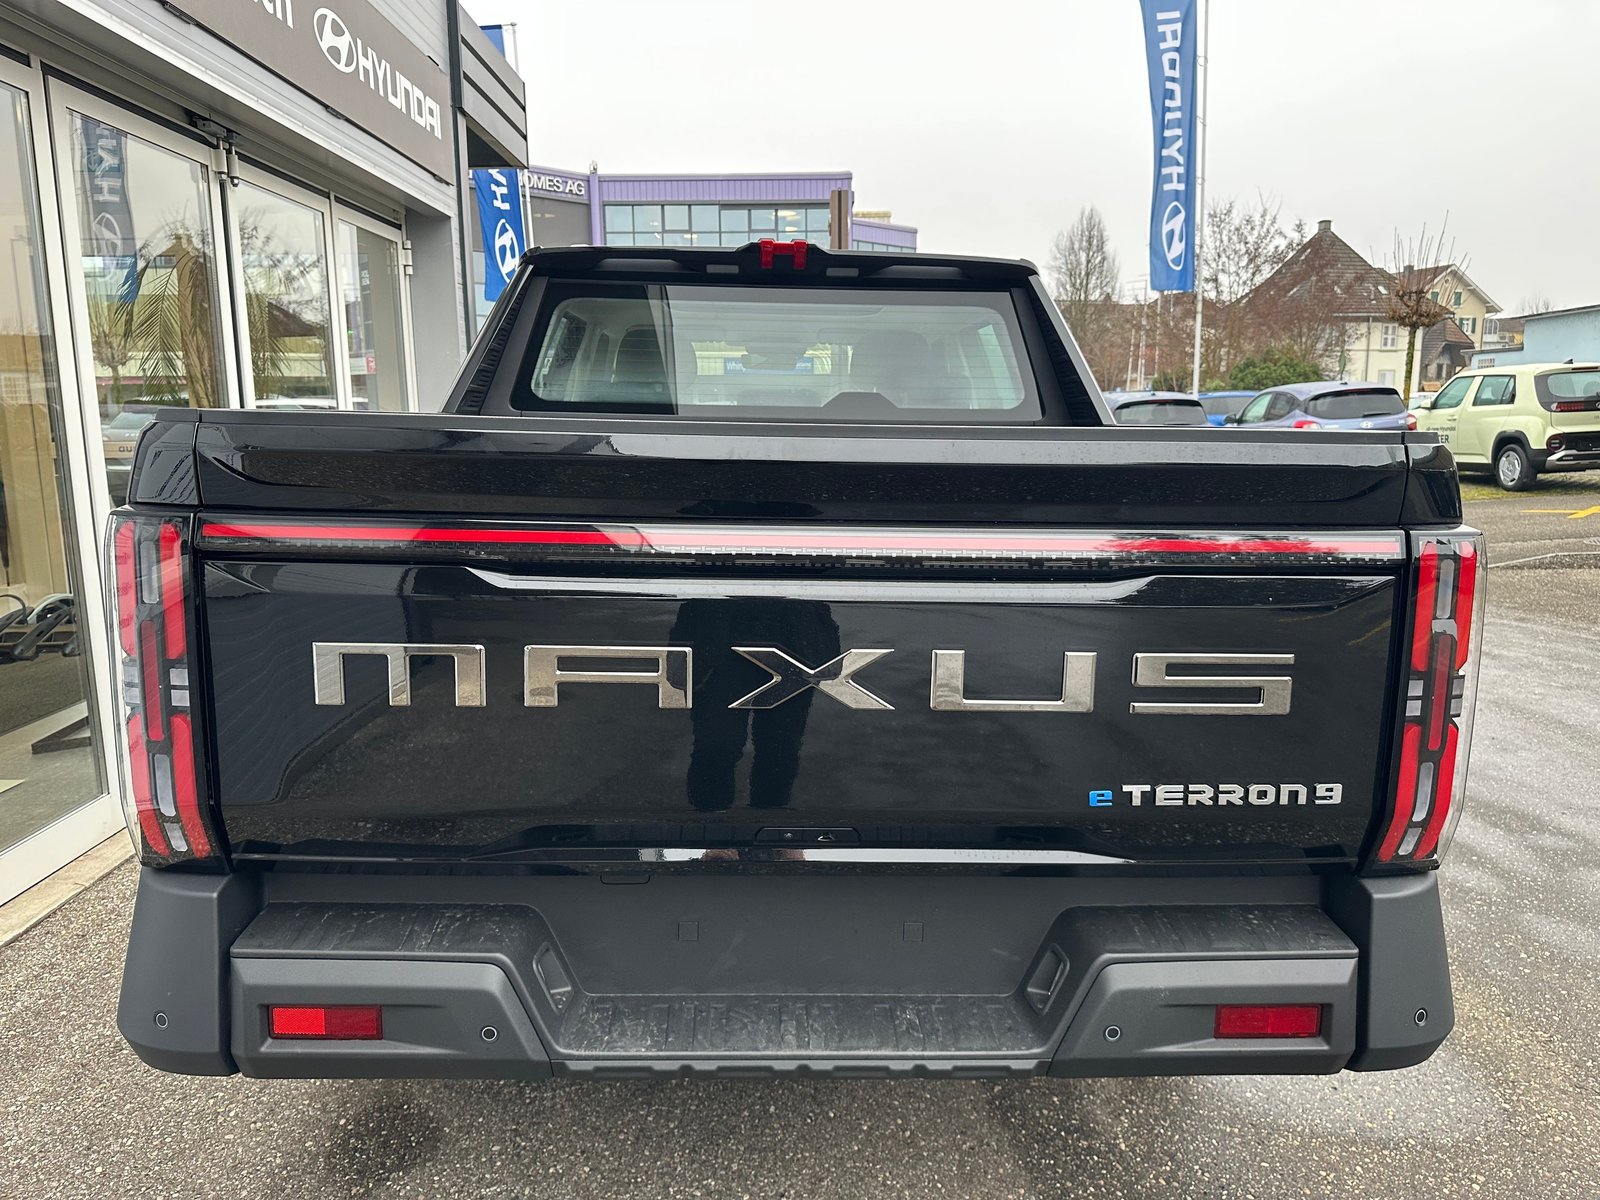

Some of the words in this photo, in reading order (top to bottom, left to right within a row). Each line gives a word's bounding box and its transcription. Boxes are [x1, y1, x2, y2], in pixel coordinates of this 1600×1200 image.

[356, 37, 442, 141] HYUNDAI
[565, 180, 586, 196] AG
[312, 641, 1296, 716] MAXUS
